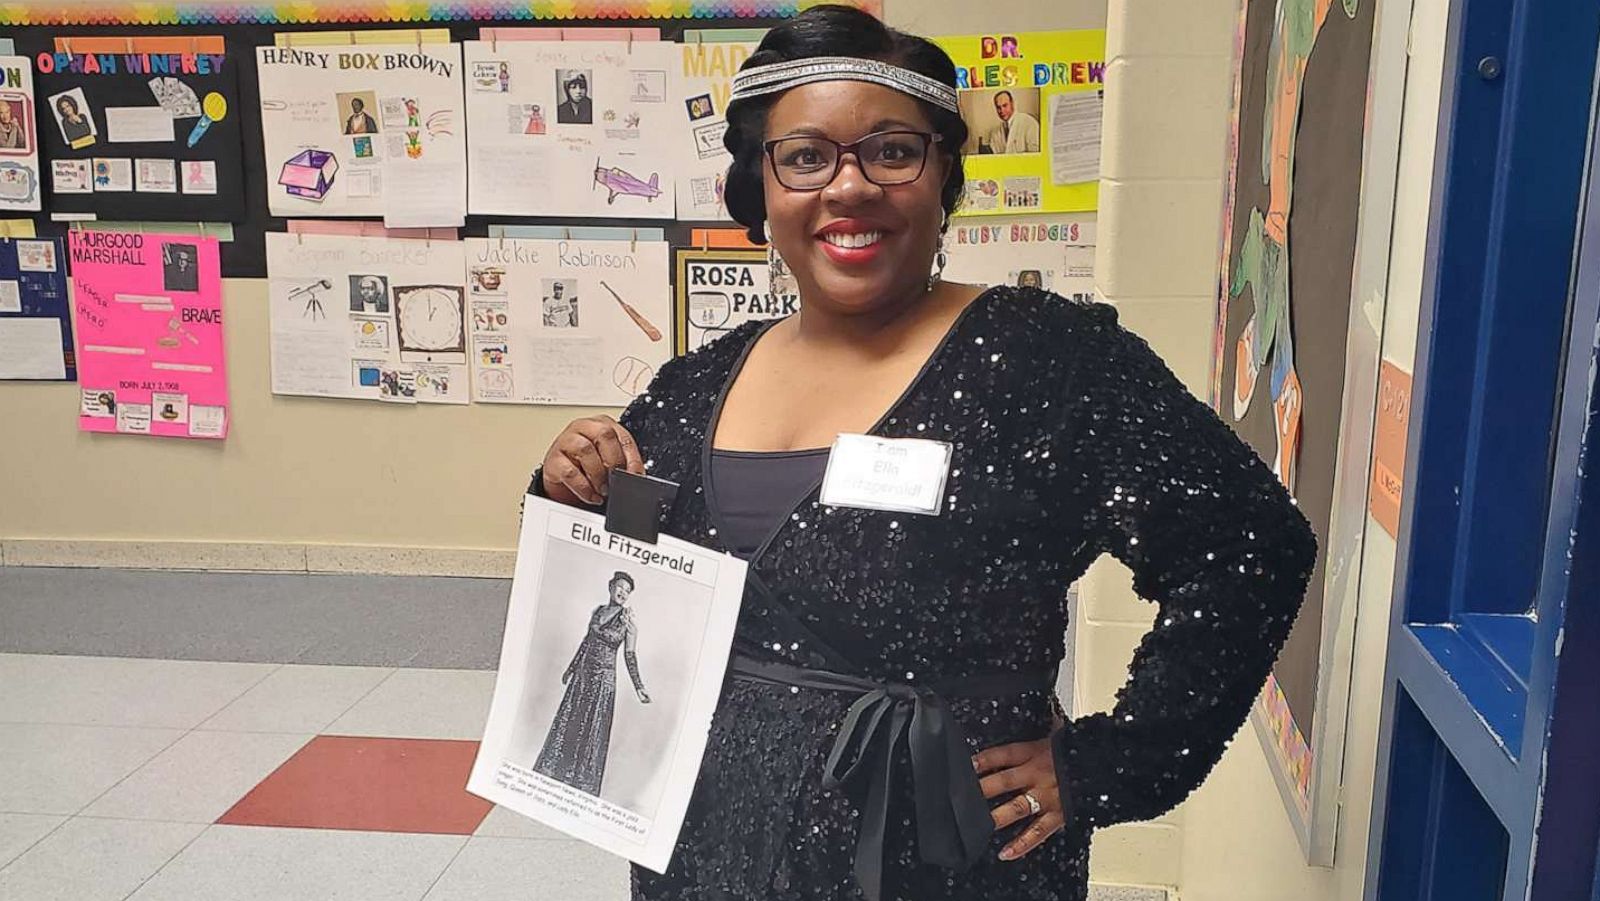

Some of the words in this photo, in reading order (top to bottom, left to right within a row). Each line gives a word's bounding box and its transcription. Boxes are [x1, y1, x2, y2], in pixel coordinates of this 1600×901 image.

[981, 37, 1023, 59] DR.
[37, 52, 117, 74] OPRAH
[125, 53, 225, 75] WINFREY
[263, 49, 329, 69] HENRY
[338, 53, 380, 70] BOX
[384, 53, 454, 78] BROWN
[683, 45, 748, 77] MAD
[956, 66, 1018, 88] RLES
[1033, 62, 1106, 87] DREW
[71, 231, 144, 249] THURGOOD
[957, 226, 1000, 245] RUBY
[1010, 223, 1080, 243] BRIDGES
[73, 249, 146, 265] MARSHALL
[477, 241, 539, 264] Jackie
[558, 241, 636, 268] Robinson
[691, 266, 754, 287] ROSA
[733, 293, 798, 315] PARK
[181, 308, 222, 324] BRAVE
[119, 381, 139, 389] BORN
[141, 381, 155, 390] JULY
[887, 446, 907, 457] am
[873, 459, 900, 476] Ella
[571, 523, 601, 545] Ella
[608, 535, 694, 575] Fitzgerald
